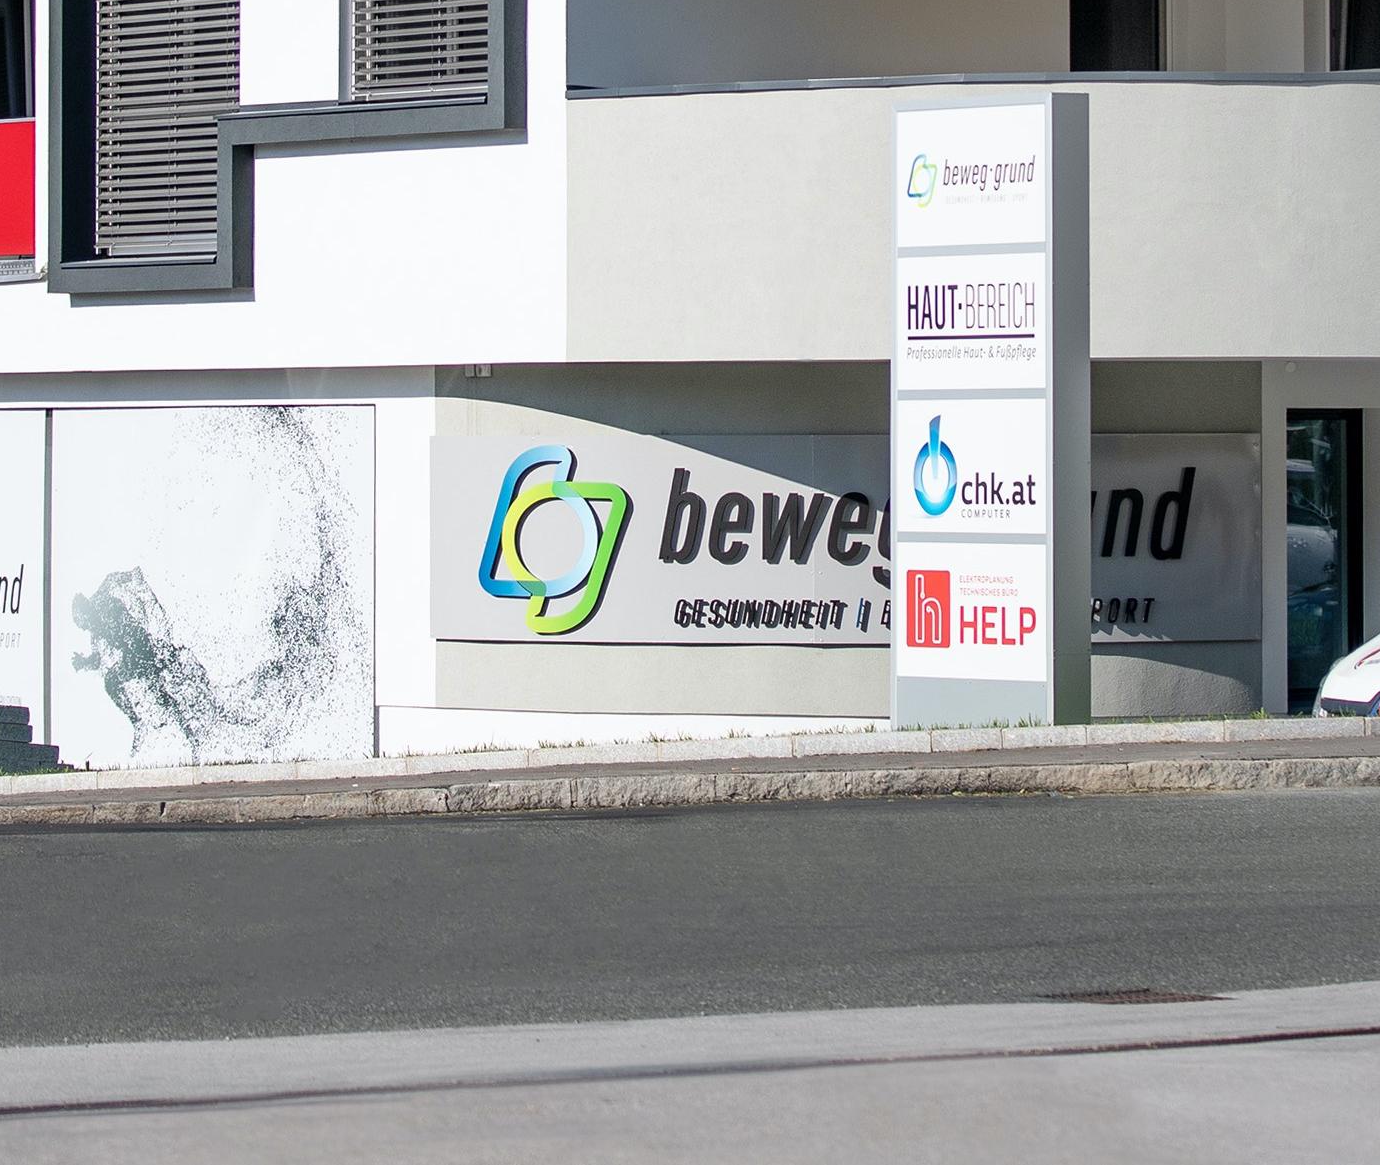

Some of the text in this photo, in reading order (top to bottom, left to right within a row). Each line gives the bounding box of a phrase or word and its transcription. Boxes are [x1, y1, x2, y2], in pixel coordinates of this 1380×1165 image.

[906, 344, 1037, 362] Professionelle Haut- & Fußpflege
[961, 472, 1036, 505] chk.at
[960, 509, 1011, 518] COMPUTER
[959, 575, 1014, 584] ELEKTROPLANUNG
[959, 587, 1001, 596] TECHNISCHES
[674, 599, 846, 628] GESUNDHEIT
[959, 605, 1037, 646] HELP
